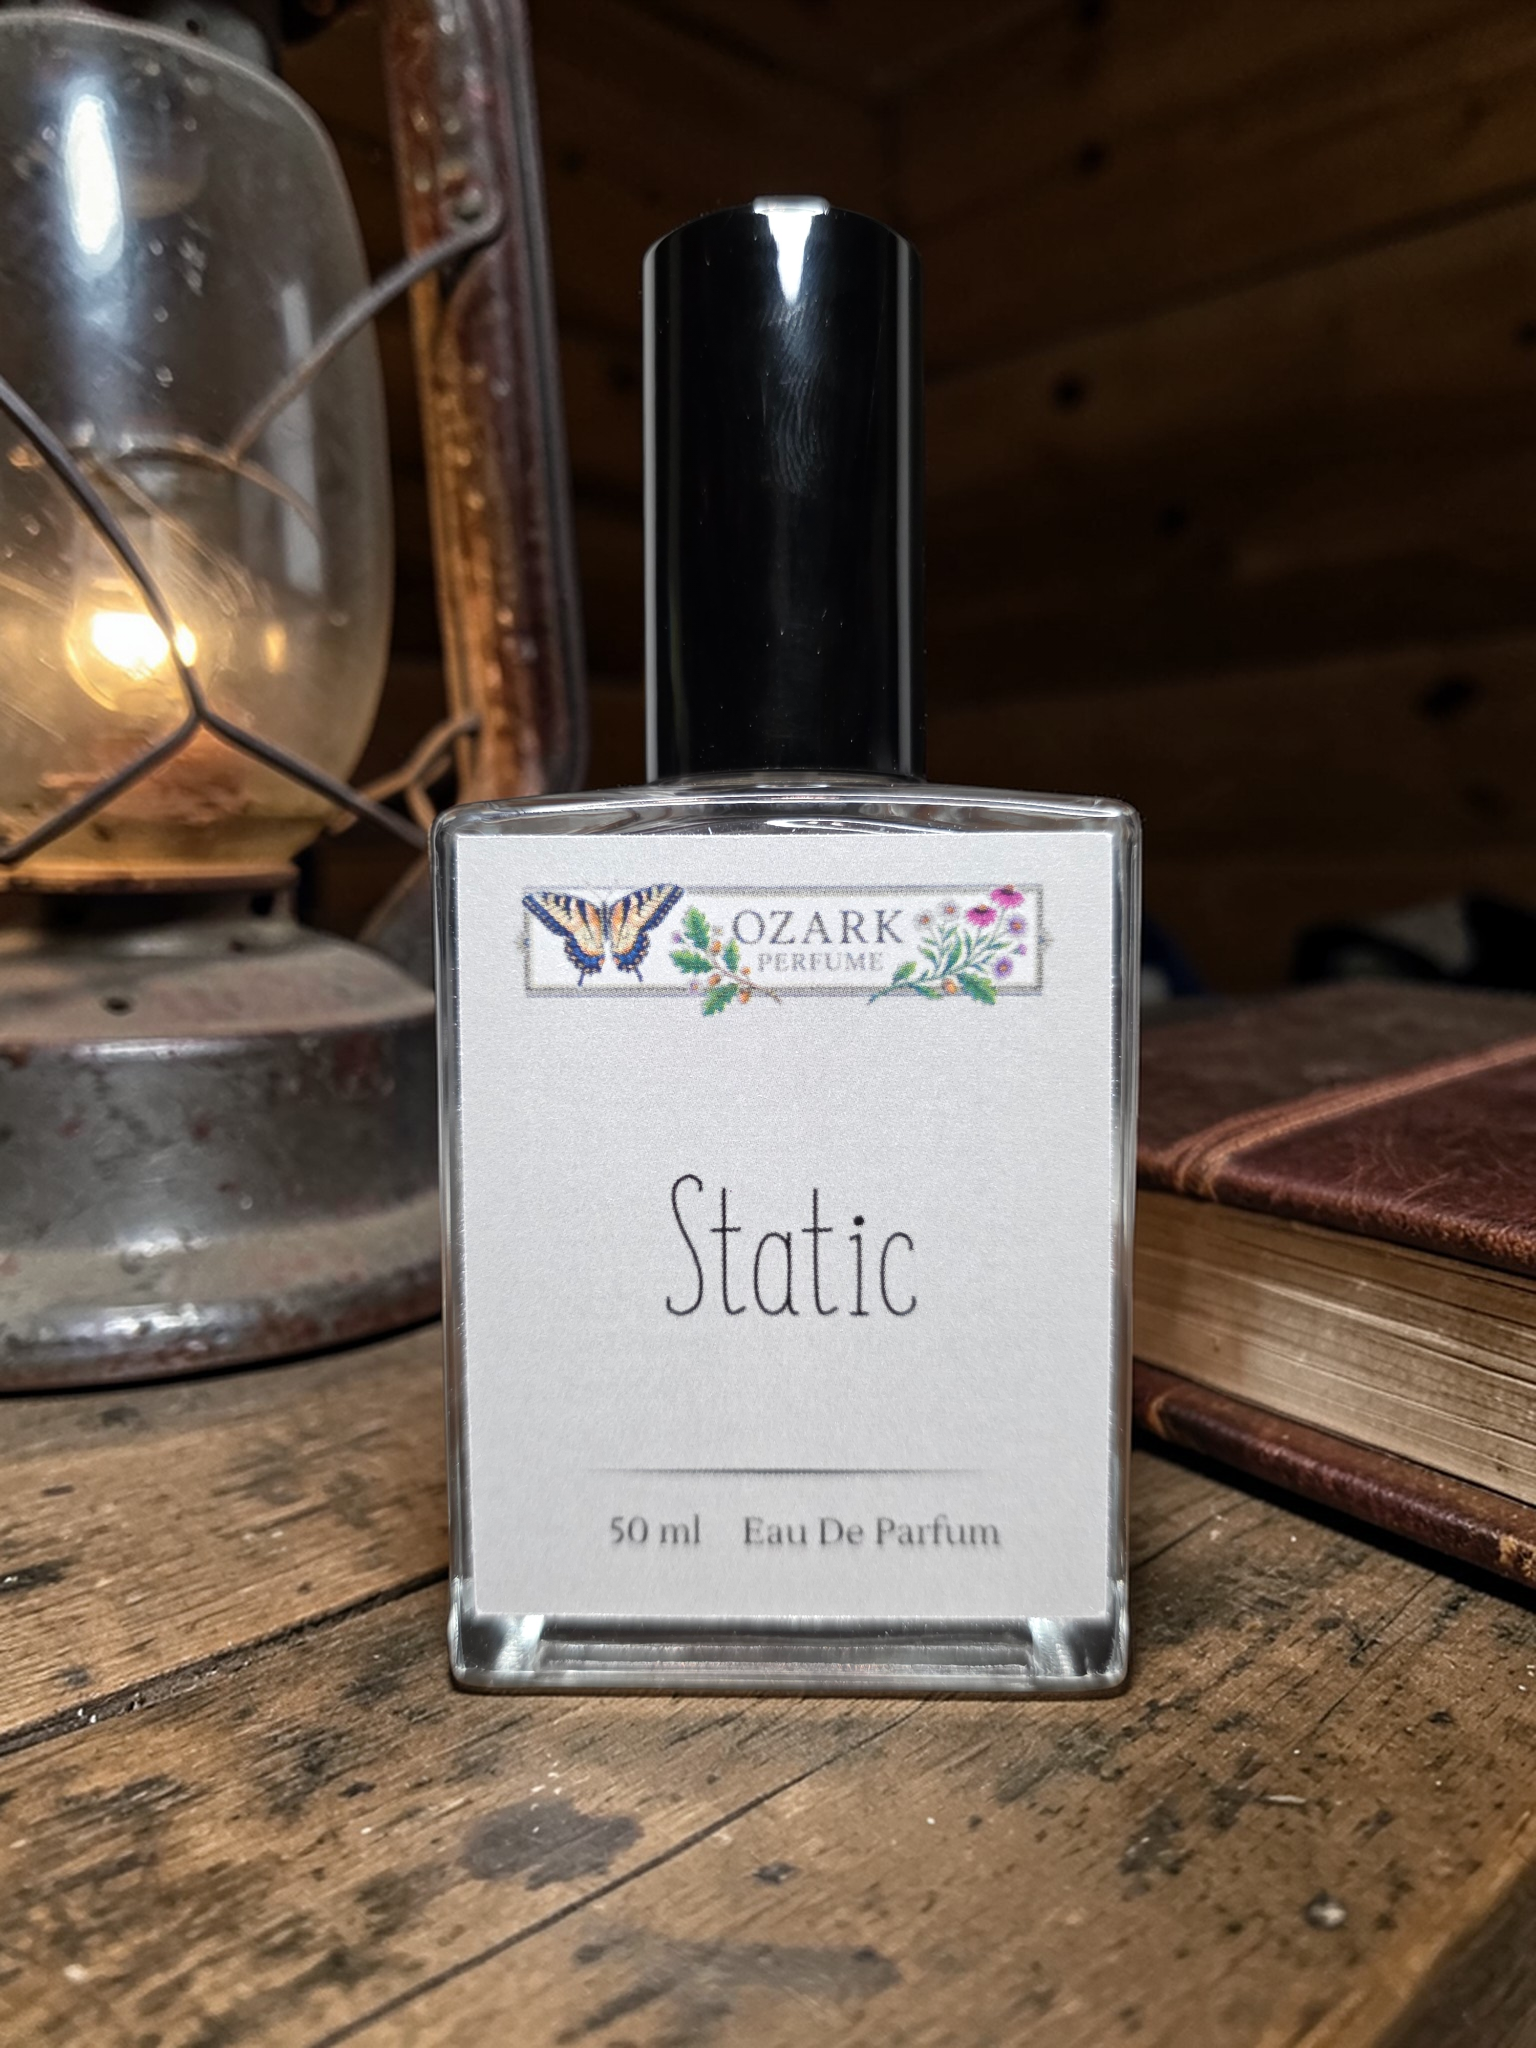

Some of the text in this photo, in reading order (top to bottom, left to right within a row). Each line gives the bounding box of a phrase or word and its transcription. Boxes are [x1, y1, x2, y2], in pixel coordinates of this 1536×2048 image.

[731, 908, 904, 945] OZARK
[757, 952, 884, 972] PERFUME
[664, 1174, 919, 1318] Static
[609, 1513, 1001, 1547] 50 ml Eau De Parfum
